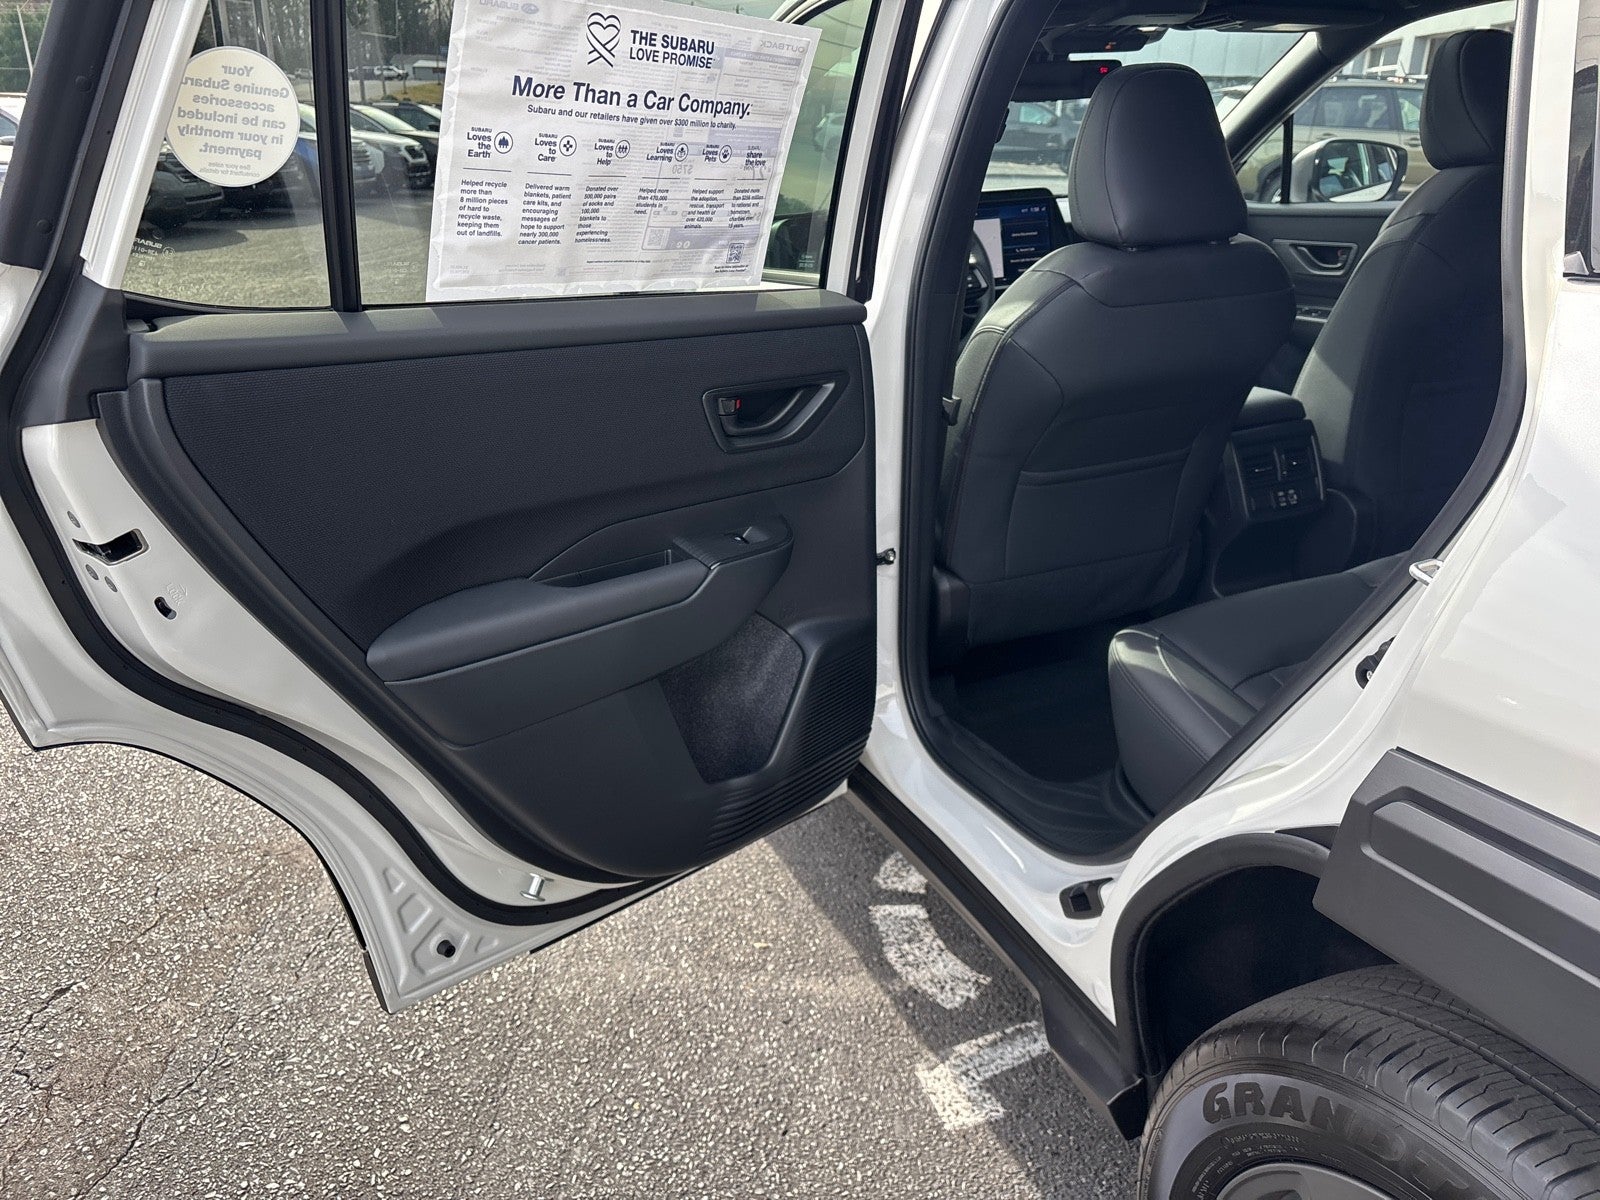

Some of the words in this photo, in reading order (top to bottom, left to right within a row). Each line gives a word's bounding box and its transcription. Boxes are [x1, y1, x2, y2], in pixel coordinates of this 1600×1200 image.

[630, 29, 657, 47] THE
[661, 34, 715, 55] SUBARU
[629, 48, 659, 62] LOVE
[662, 52, 713, 69] PROMISE
[511, 75, 566, 100] More
[573, 82, 621, 106] Than
[626, 93, 638, 108] a
[643, 90, 674, 111] Car
[678, 93, 751, 119] Company.
[527, 104, 556, 115] Subaru
[558, 108, 573, 117] and
[590, 111, 620, 122] retailers
[622, 114, 638, 124] have
[640, 116, 658, 127] given
[674, 118, 689, 128] $300
[690, 119, 709, 128] million
[716, 122, 737, 130] charity.
[467, 132, 492, 141] Loves
[478, 142, 491, 150] the
[535, 138, 557, 147] Loves
[468, 149, 490, 158] Earth
[656, 146, 674, 154] Loves
[538, 154, 555, 162] Care
[646, 154, 672, 162] Learning
[746, 151, 762, 159] share
